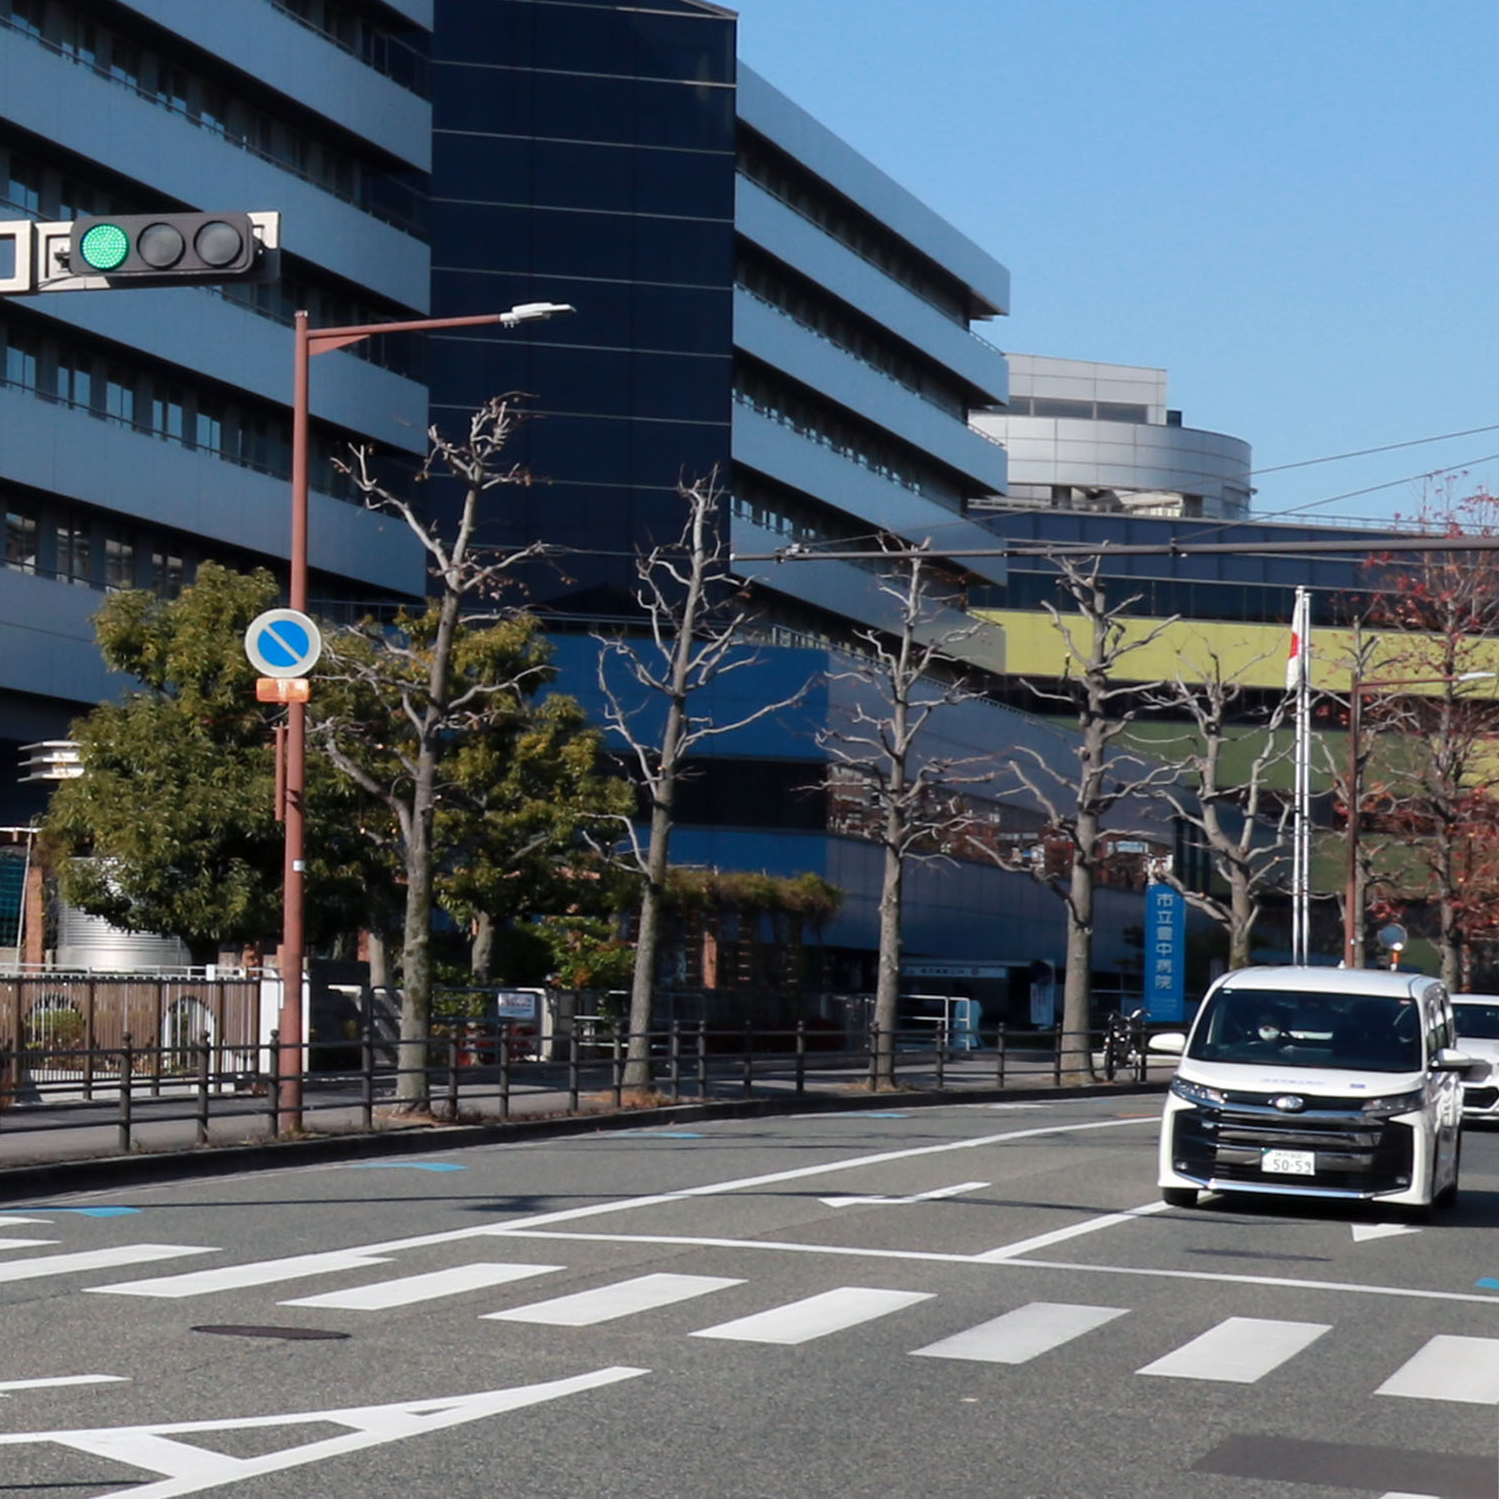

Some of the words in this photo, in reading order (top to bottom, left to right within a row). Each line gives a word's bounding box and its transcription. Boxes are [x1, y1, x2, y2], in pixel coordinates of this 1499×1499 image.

[1155, 893, 1173, 990] 市立豊中病院
